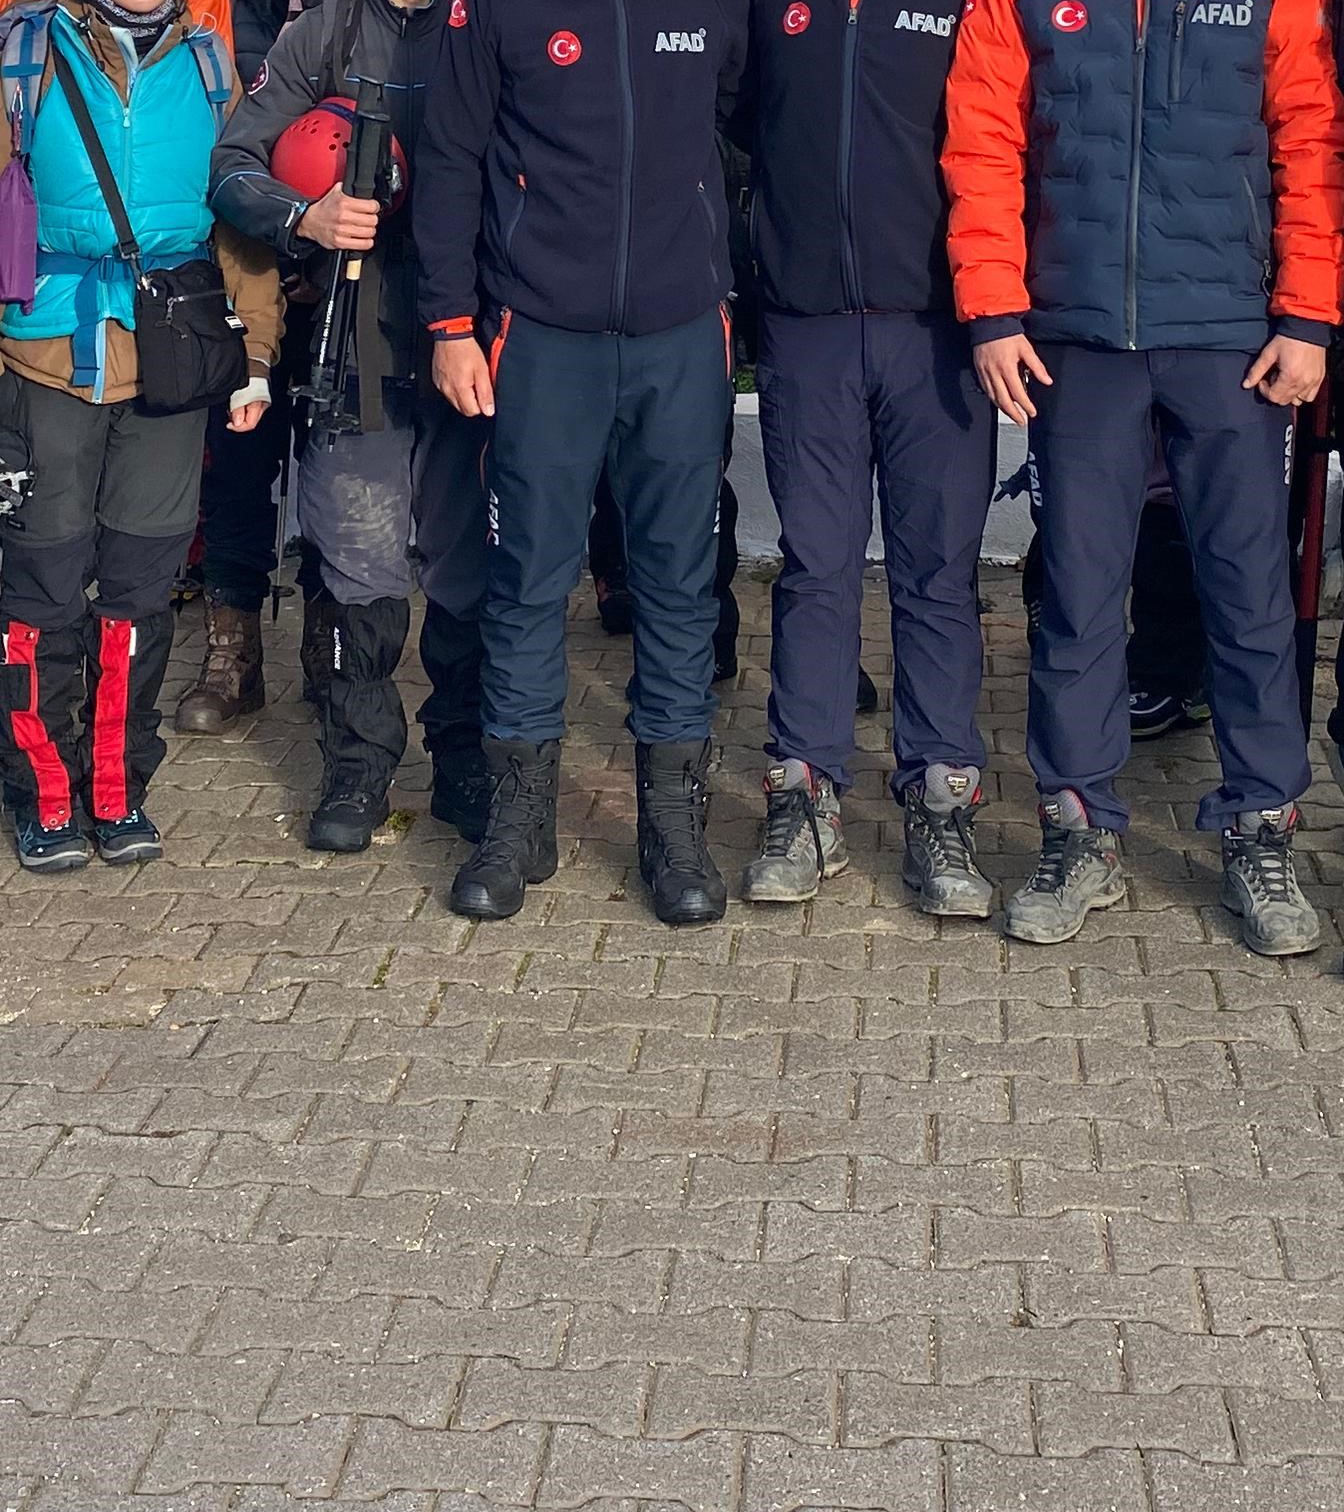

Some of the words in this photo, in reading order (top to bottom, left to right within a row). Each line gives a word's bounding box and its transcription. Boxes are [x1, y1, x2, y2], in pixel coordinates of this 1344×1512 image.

[894, 10, 951, 37] AFAD
[1191, 3, 1252, 26] AFAD
[654, 31, 705, 53] AFAD
